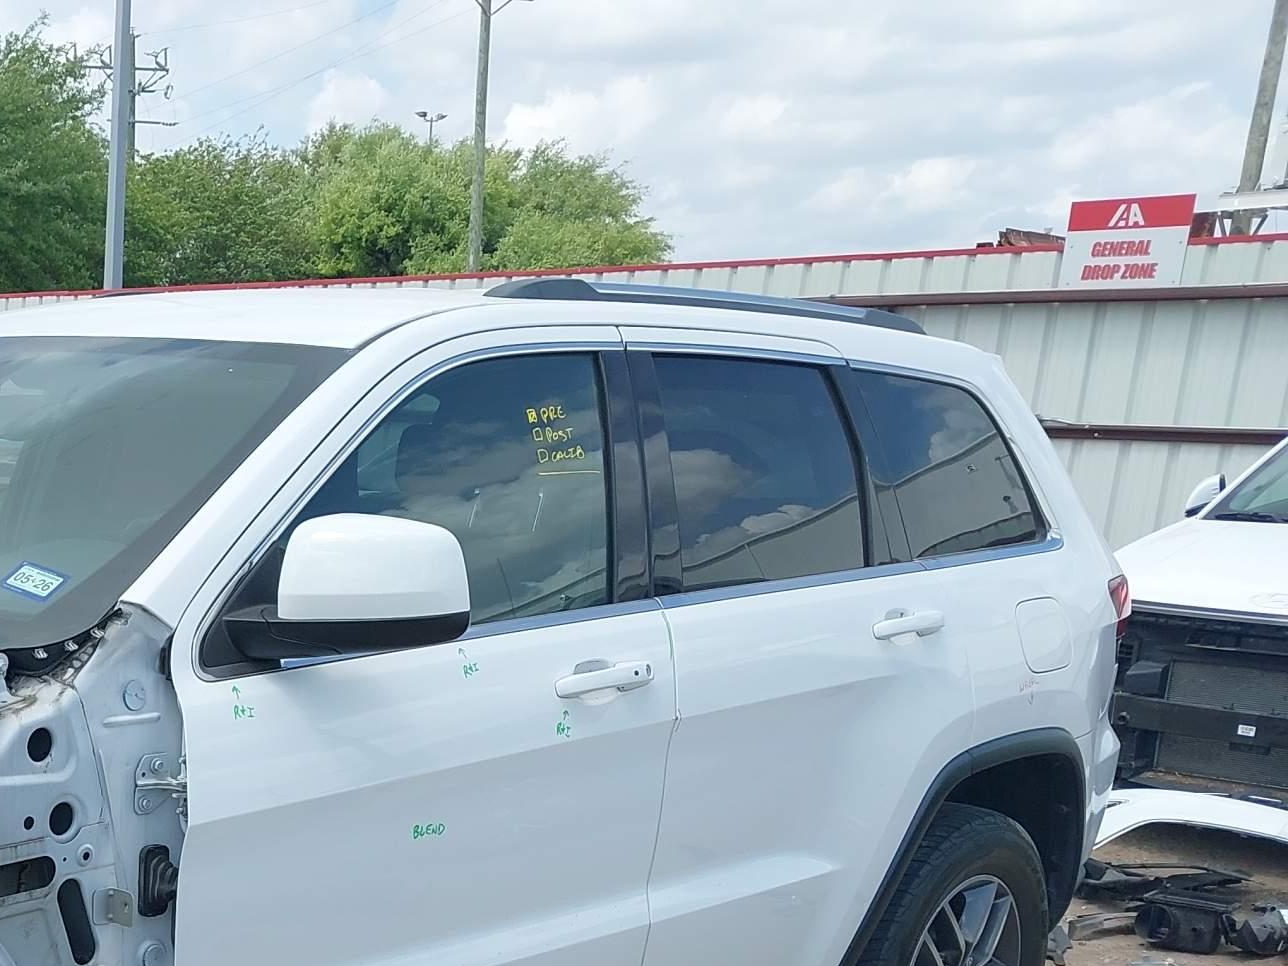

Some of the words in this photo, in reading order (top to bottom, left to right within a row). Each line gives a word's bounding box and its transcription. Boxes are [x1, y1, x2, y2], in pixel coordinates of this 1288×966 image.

[1090, 239, 1152, 258] GENERAL
[1080, 263, 1121, 281] DROP
[1120, 262, 1159, 279] ZONE
[540, 406, 567, 424] PRE
[545, 426, 574, 443] POST
[413, 823, 446, 840] BLEND
